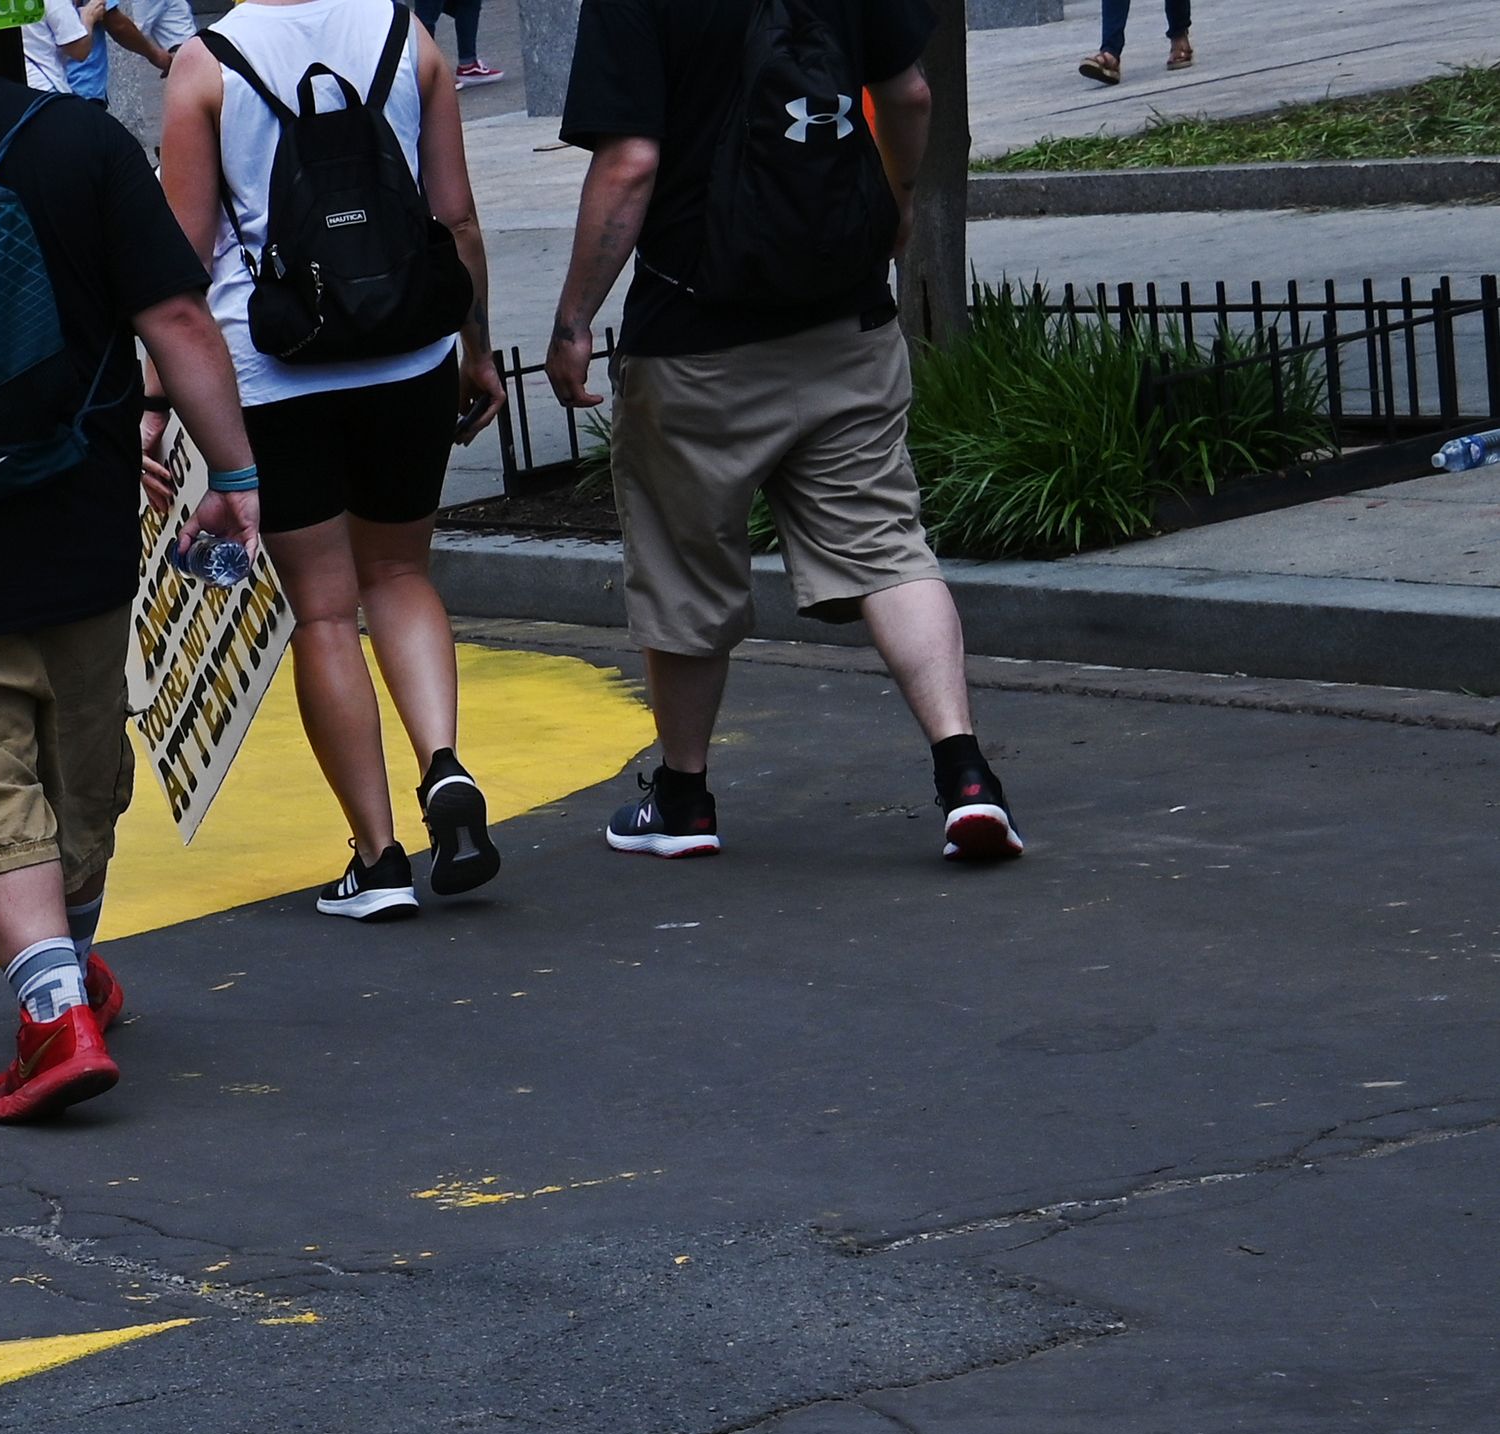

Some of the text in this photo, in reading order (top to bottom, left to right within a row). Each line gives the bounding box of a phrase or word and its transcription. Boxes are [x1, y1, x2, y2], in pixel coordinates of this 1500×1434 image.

[328, 213, 363, 225] NAUTICA
[179, 599, 212, 676] NOT
[637, 803, 652, 828] N
